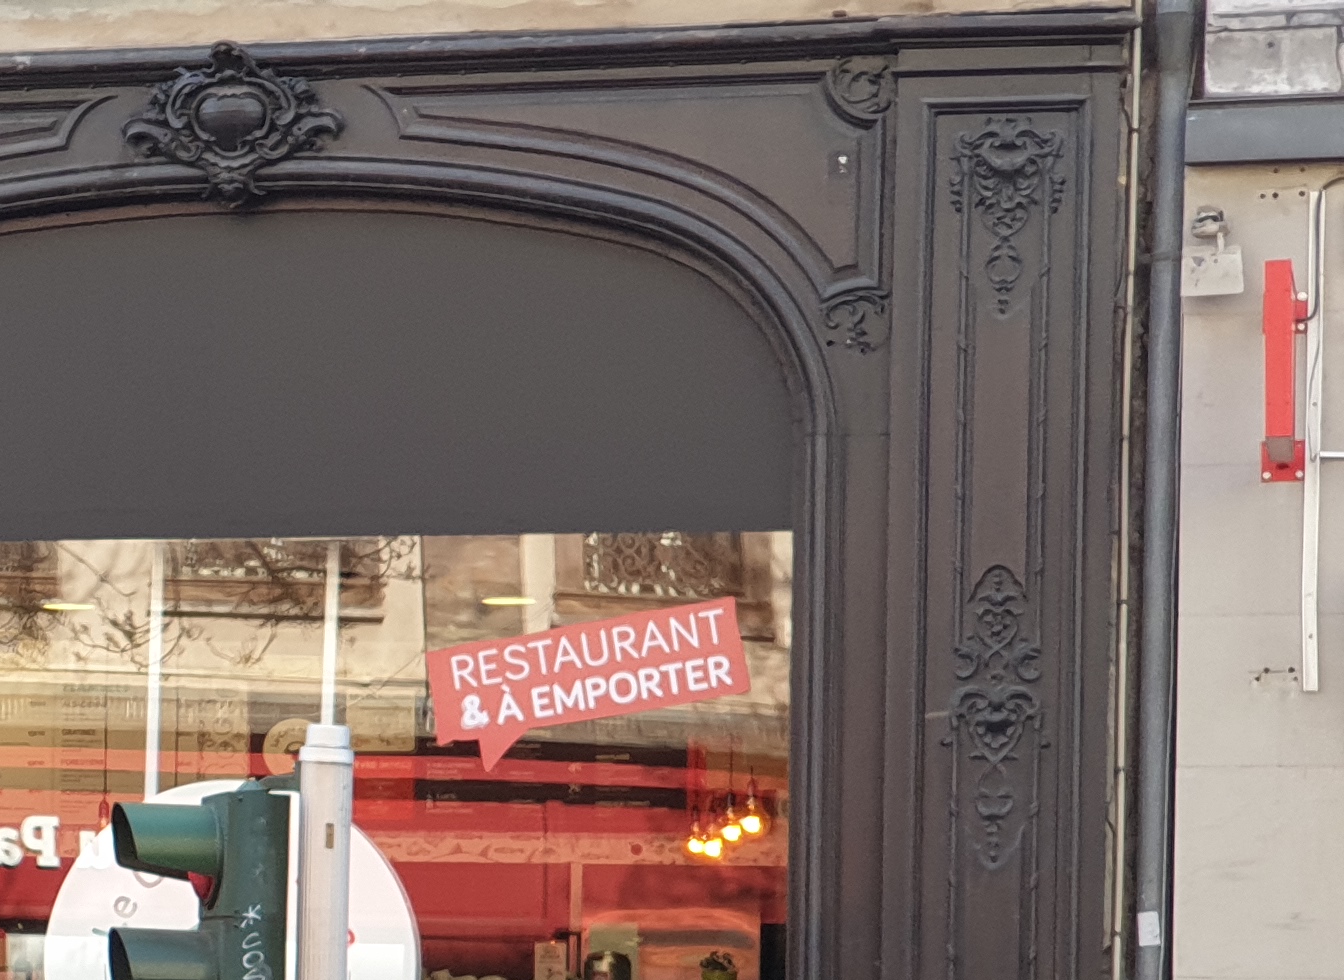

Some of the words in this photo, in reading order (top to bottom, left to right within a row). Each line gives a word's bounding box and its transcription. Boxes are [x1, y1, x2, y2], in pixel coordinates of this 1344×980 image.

[450, 608, 724, 691] RESTAURANT
[461, 694, 490, 730] &
[497, 684, 525, 726] À
[531, 655, 733, 719] EMPORTER
